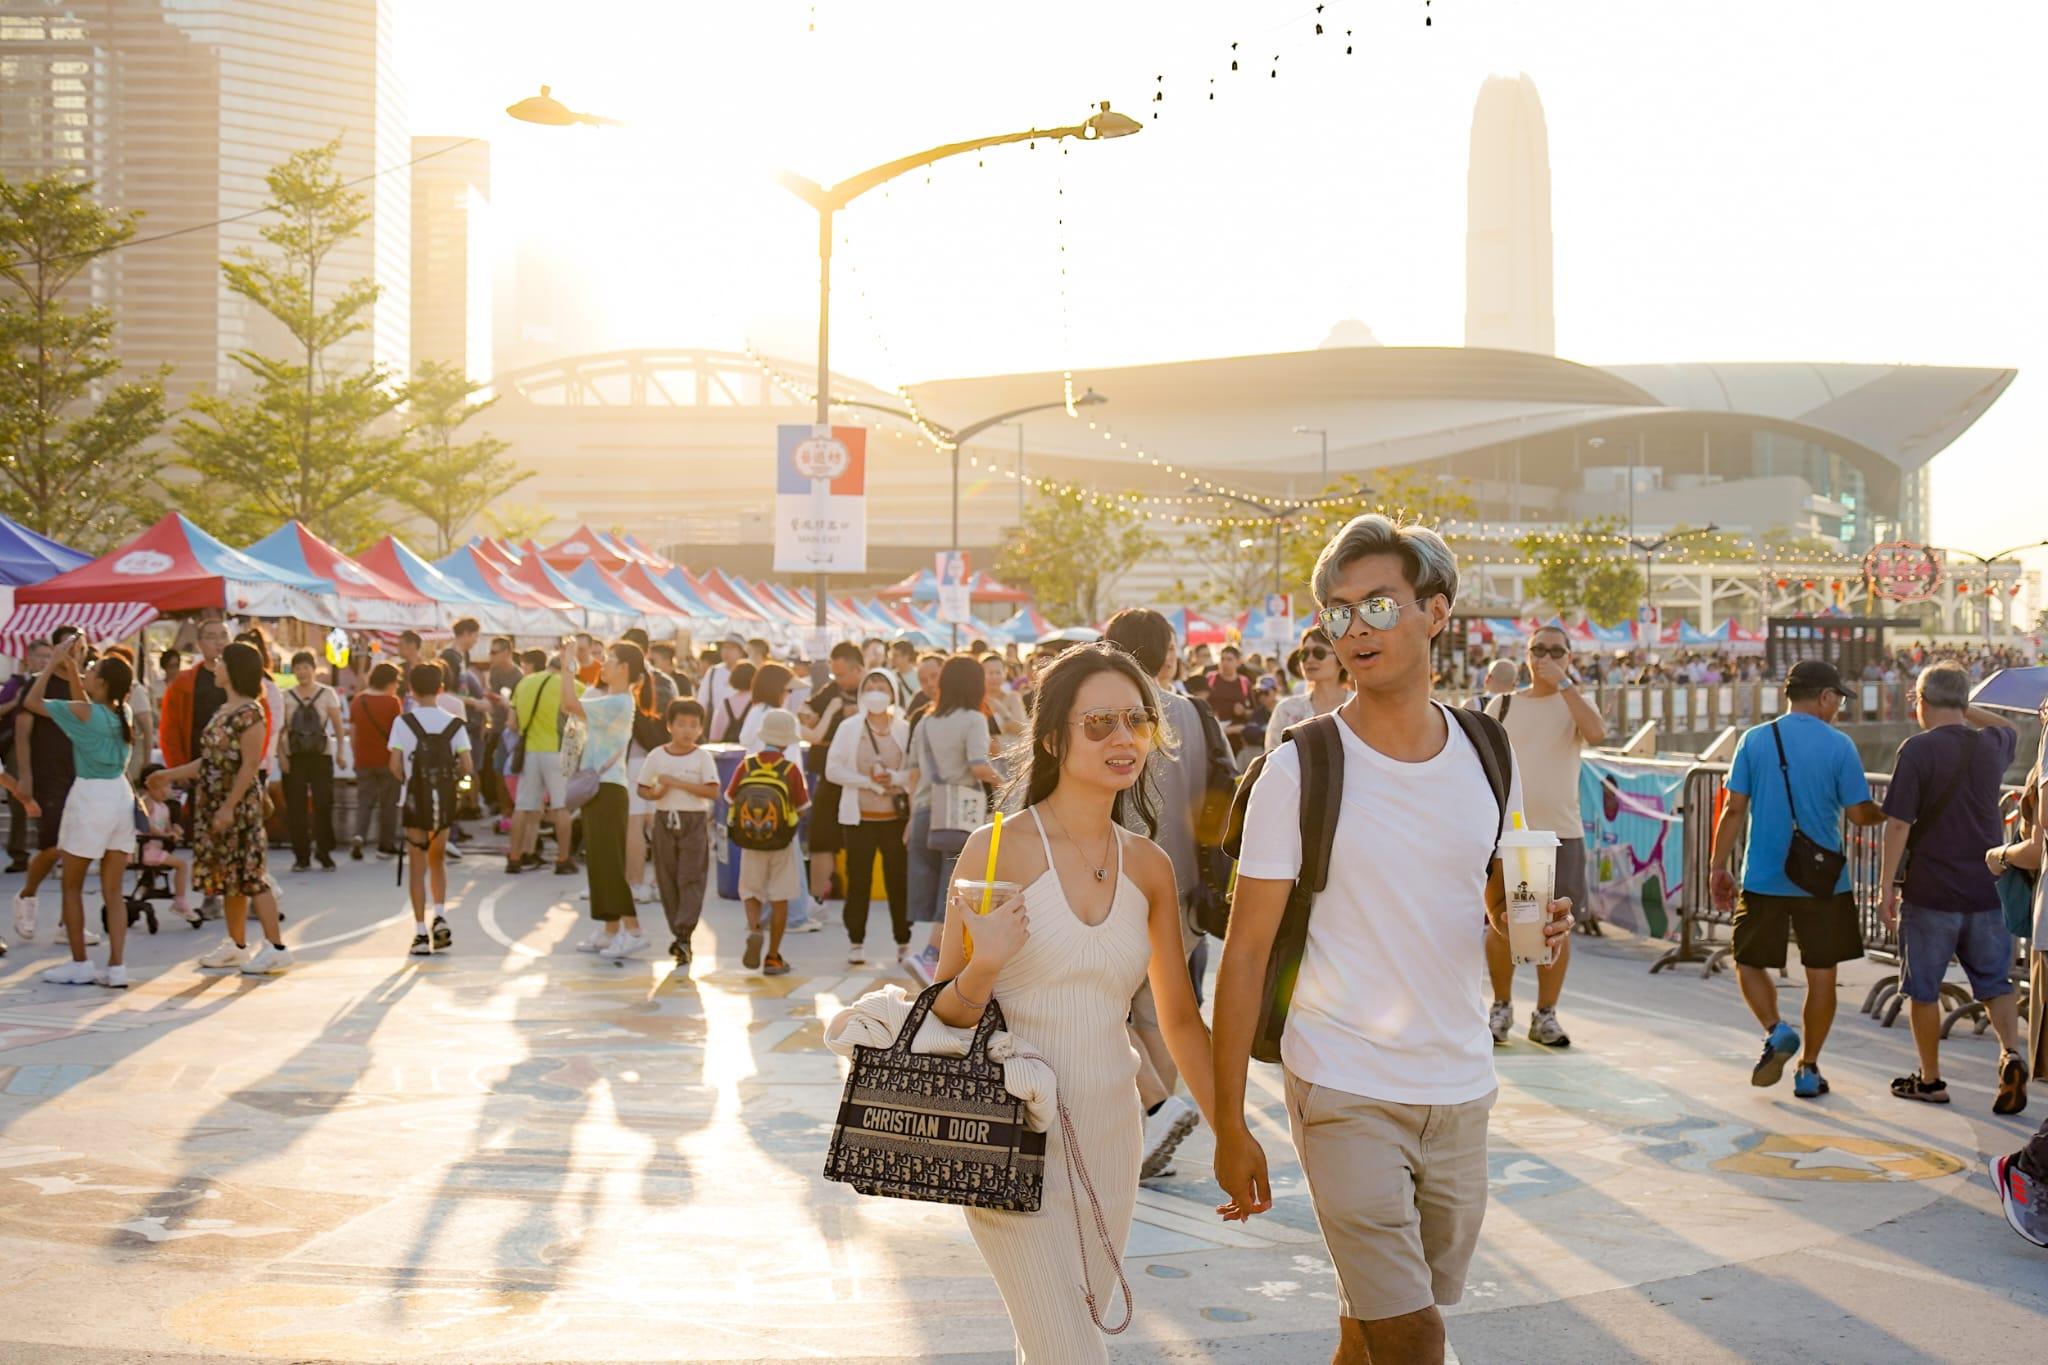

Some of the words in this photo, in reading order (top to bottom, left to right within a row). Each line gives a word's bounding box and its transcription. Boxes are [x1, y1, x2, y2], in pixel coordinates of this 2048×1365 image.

[797, 535, 819, 544] MAIN
[863, 1107, 940, 1138] CHRISTIAN
[948, 1120, 990, 1143] DIOR
